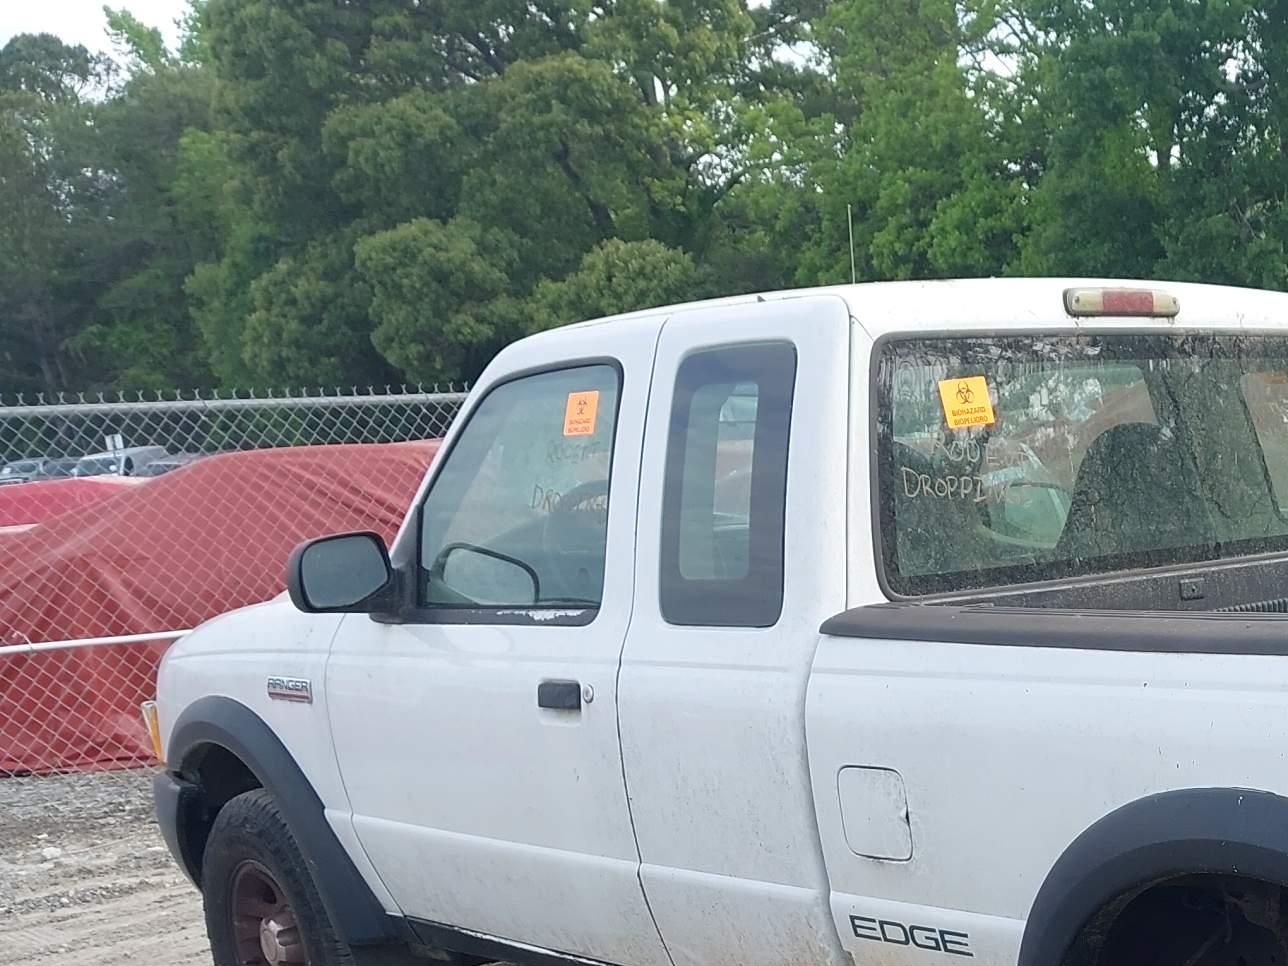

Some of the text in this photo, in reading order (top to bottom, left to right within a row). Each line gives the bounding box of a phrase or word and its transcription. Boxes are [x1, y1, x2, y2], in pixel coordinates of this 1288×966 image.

[951, 406, 986, 417] BIOHAZARD
[267, 678, 309, 692] RANGER
[849, 914, 975, 957] EDGE
